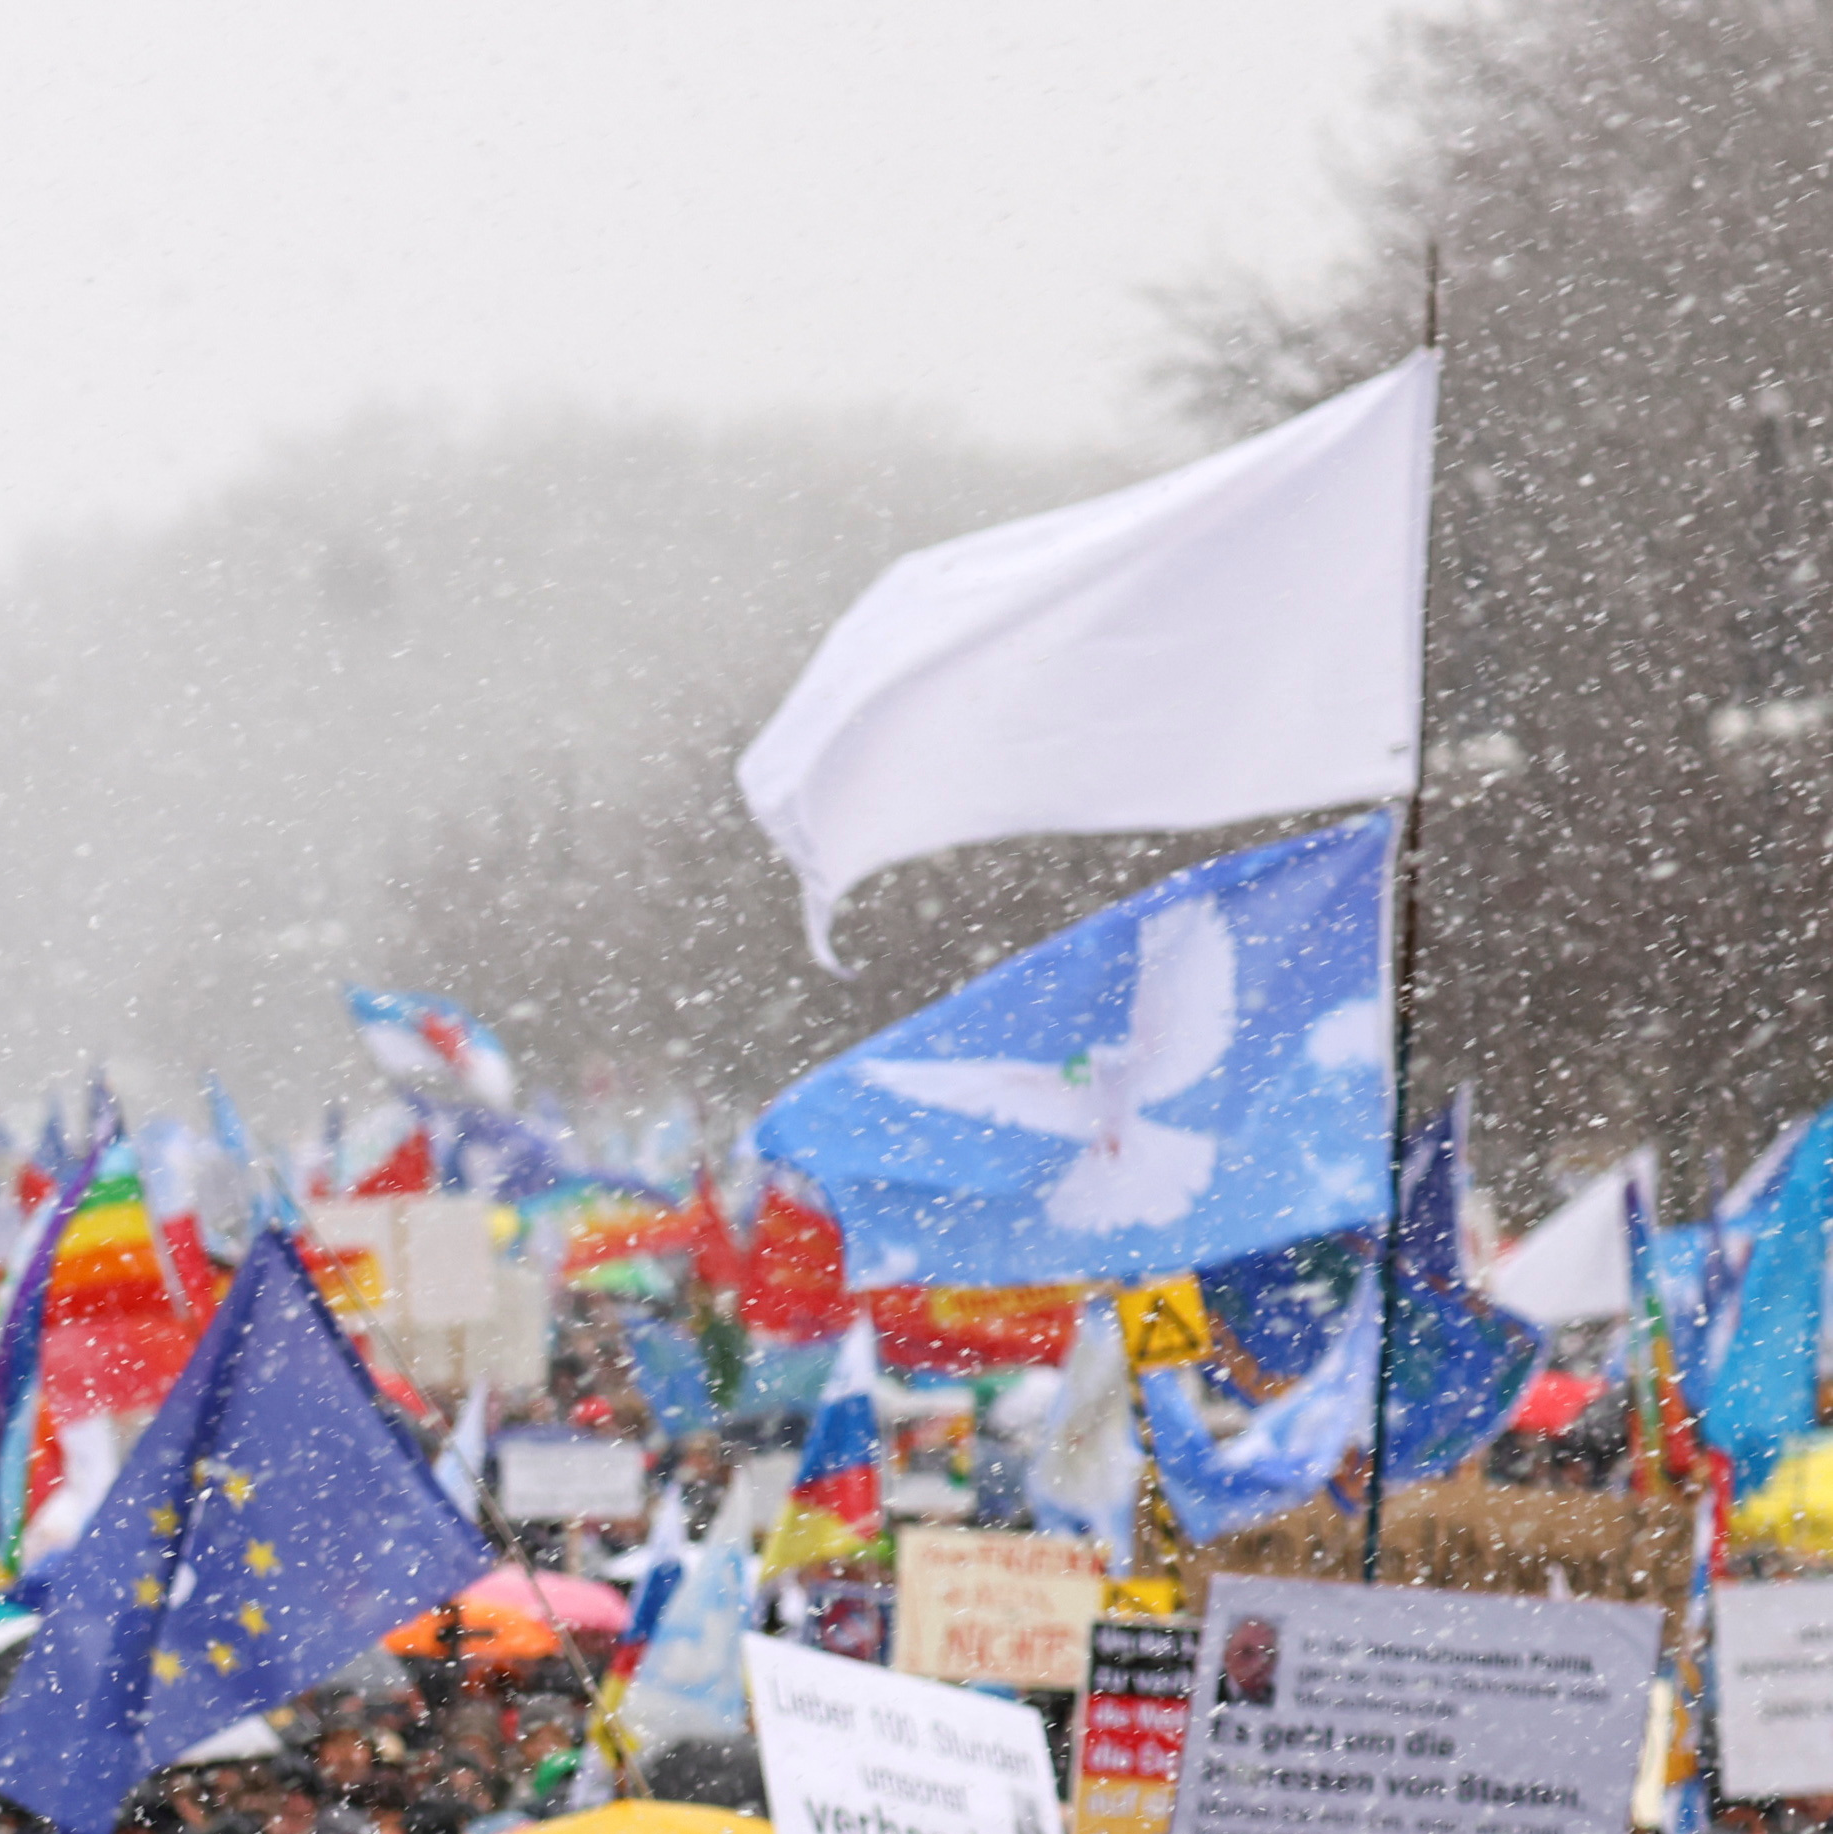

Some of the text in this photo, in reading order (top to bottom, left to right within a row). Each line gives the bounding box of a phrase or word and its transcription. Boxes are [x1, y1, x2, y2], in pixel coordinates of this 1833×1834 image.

[932, 1717, 1038, 1777] Stunden
[1260, 1720, 1335, 1755] geht
[1404, 1730, 1455, 1759] die
